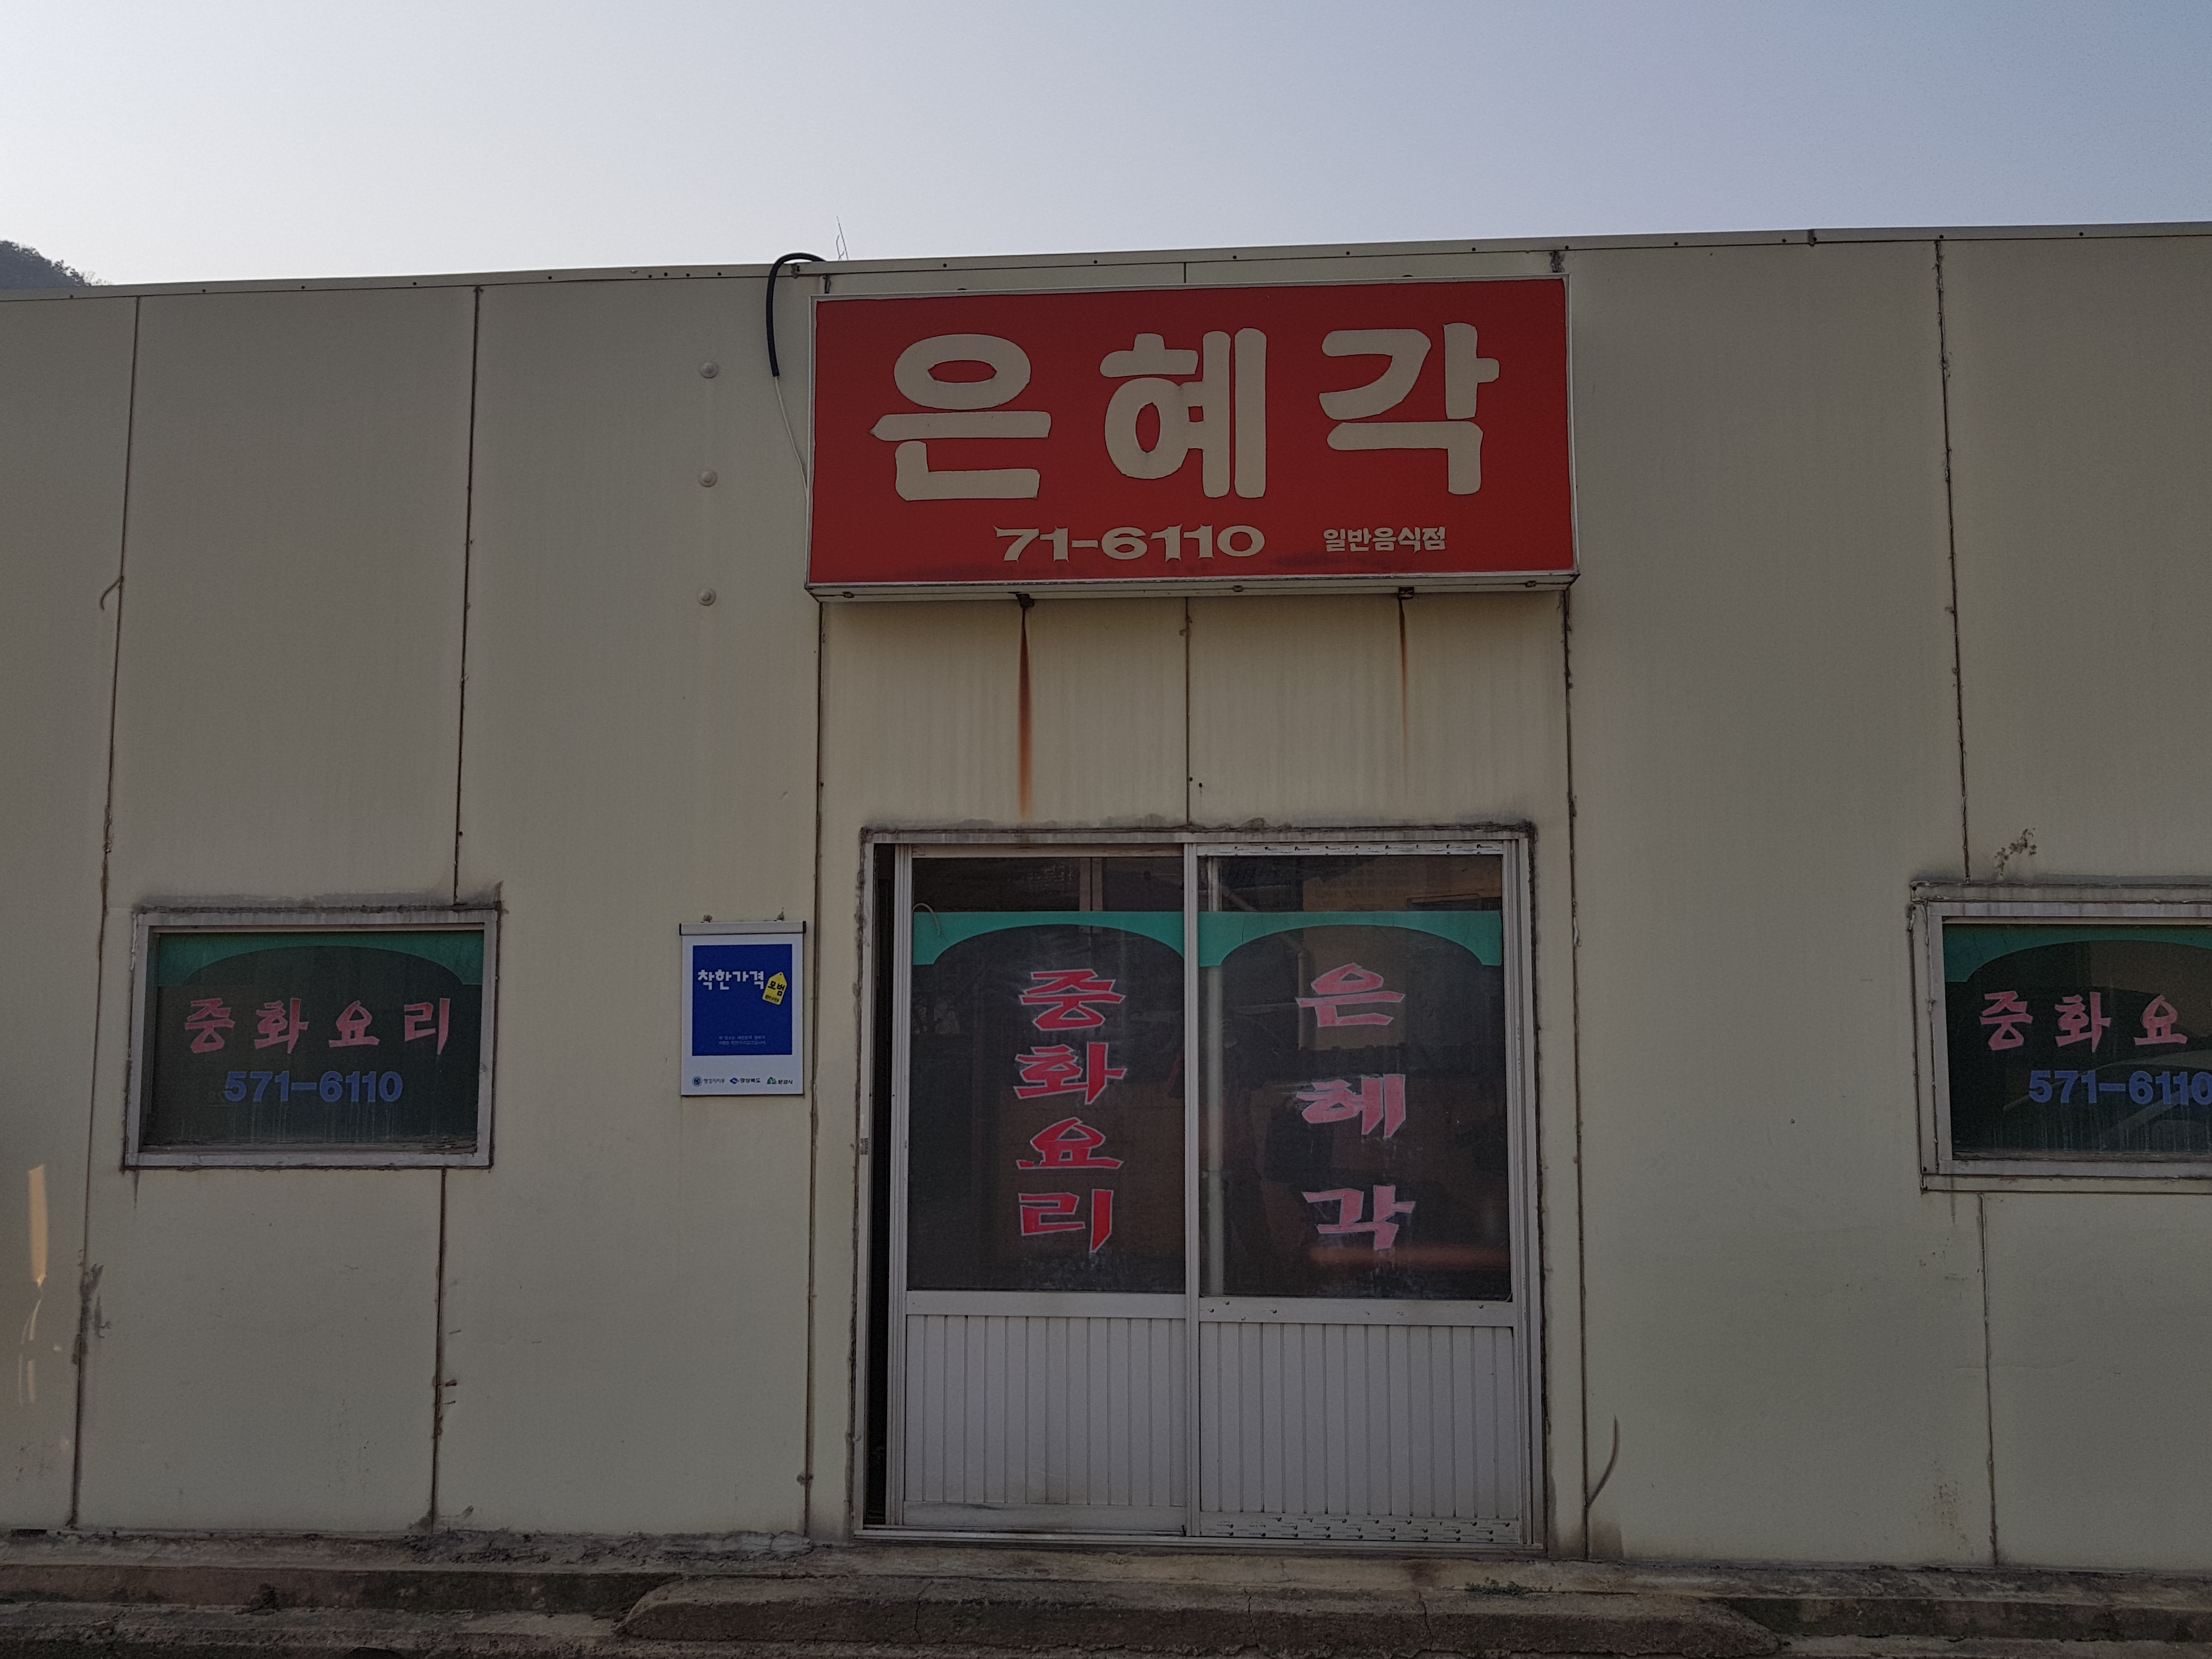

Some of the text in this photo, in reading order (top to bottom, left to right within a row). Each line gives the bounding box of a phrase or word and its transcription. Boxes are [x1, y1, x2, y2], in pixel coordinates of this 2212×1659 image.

[870, 321, 1501, 501] 은혜각
[993, 523, 1266, 563] 71-6110
[1323, 526, 1447, 554] 일반음식점
[697, 969, 764, 990] 착한가격
[768, 980, 785, 997] 모범
[184, 997, 451, 1056] 중화요리
[1979, 990, 2212, 1053] 중화요
[224, 1070, 403, 1102] 571-6110
[2029, 1070, 2212, 1106] 571-6110
[1013, 968, 1127, 1254] 중화요리
[1296, 962, 1417, 1251] 은혜각
